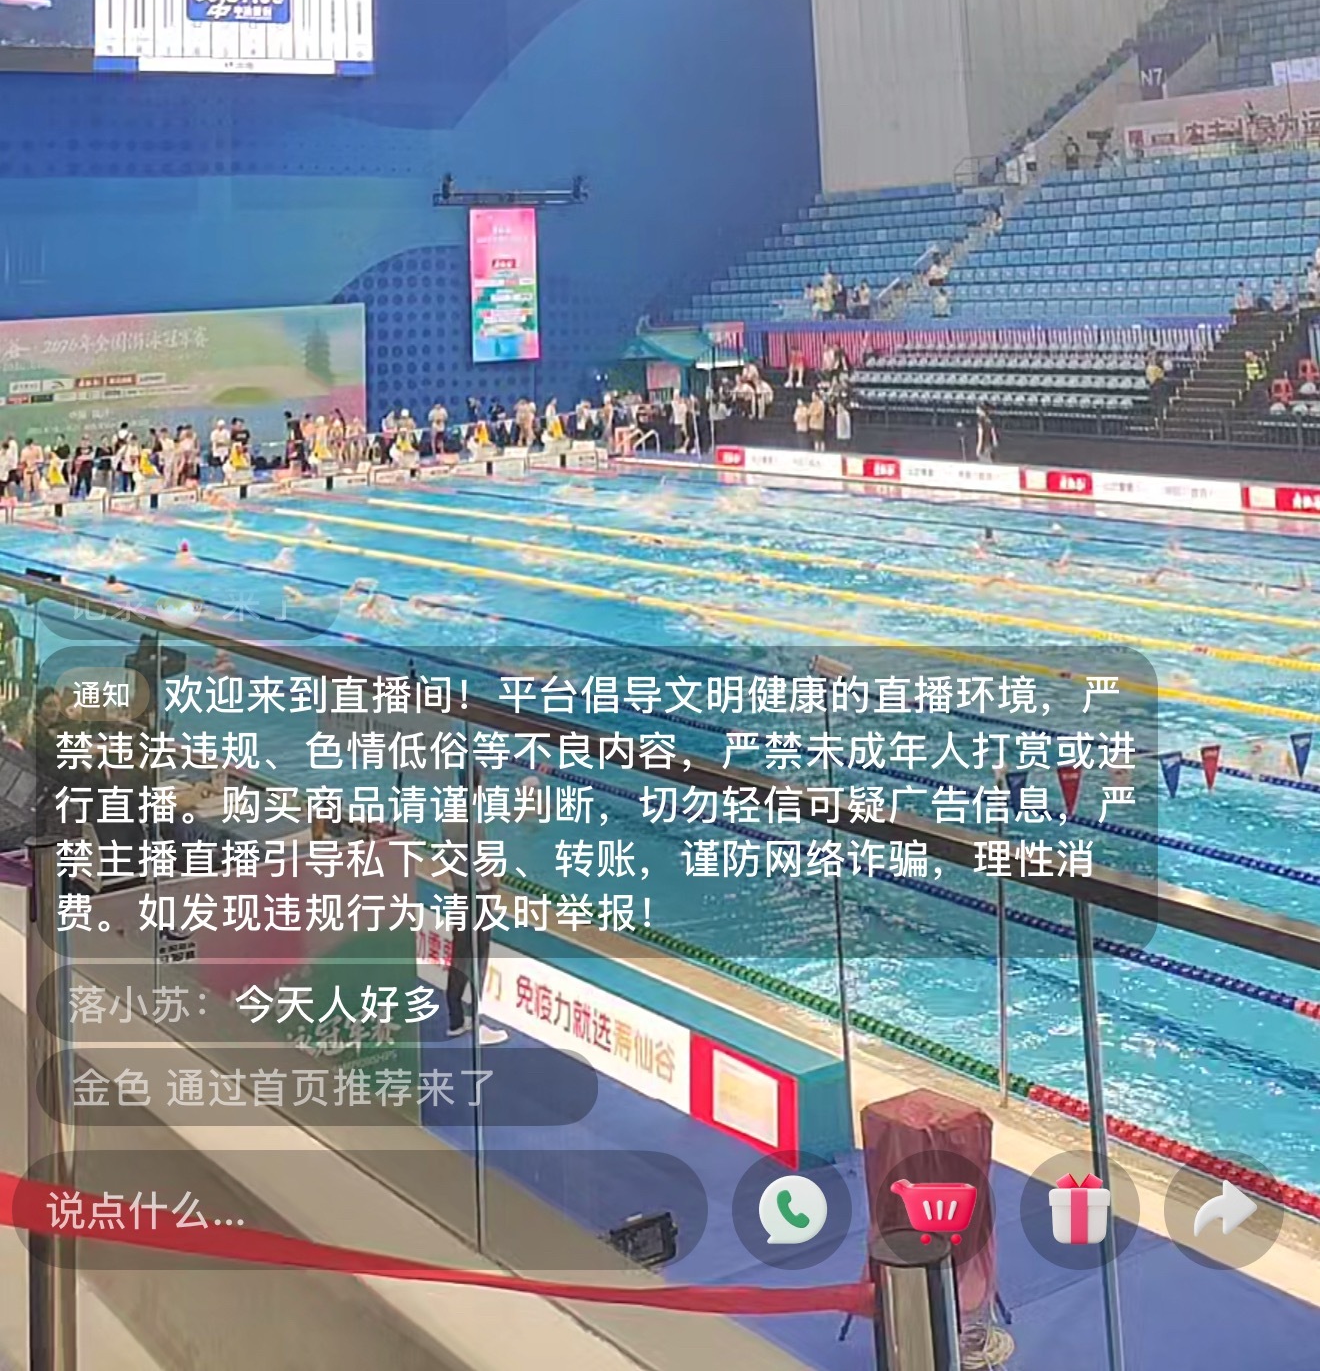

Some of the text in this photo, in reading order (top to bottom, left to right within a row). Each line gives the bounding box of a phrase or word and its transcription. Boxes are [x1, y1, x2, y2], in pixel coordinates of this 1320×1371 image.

[1140, 67, 1163, 86] N7
[515, 974, 676, 1084] 免疫力就选寿仙谷
